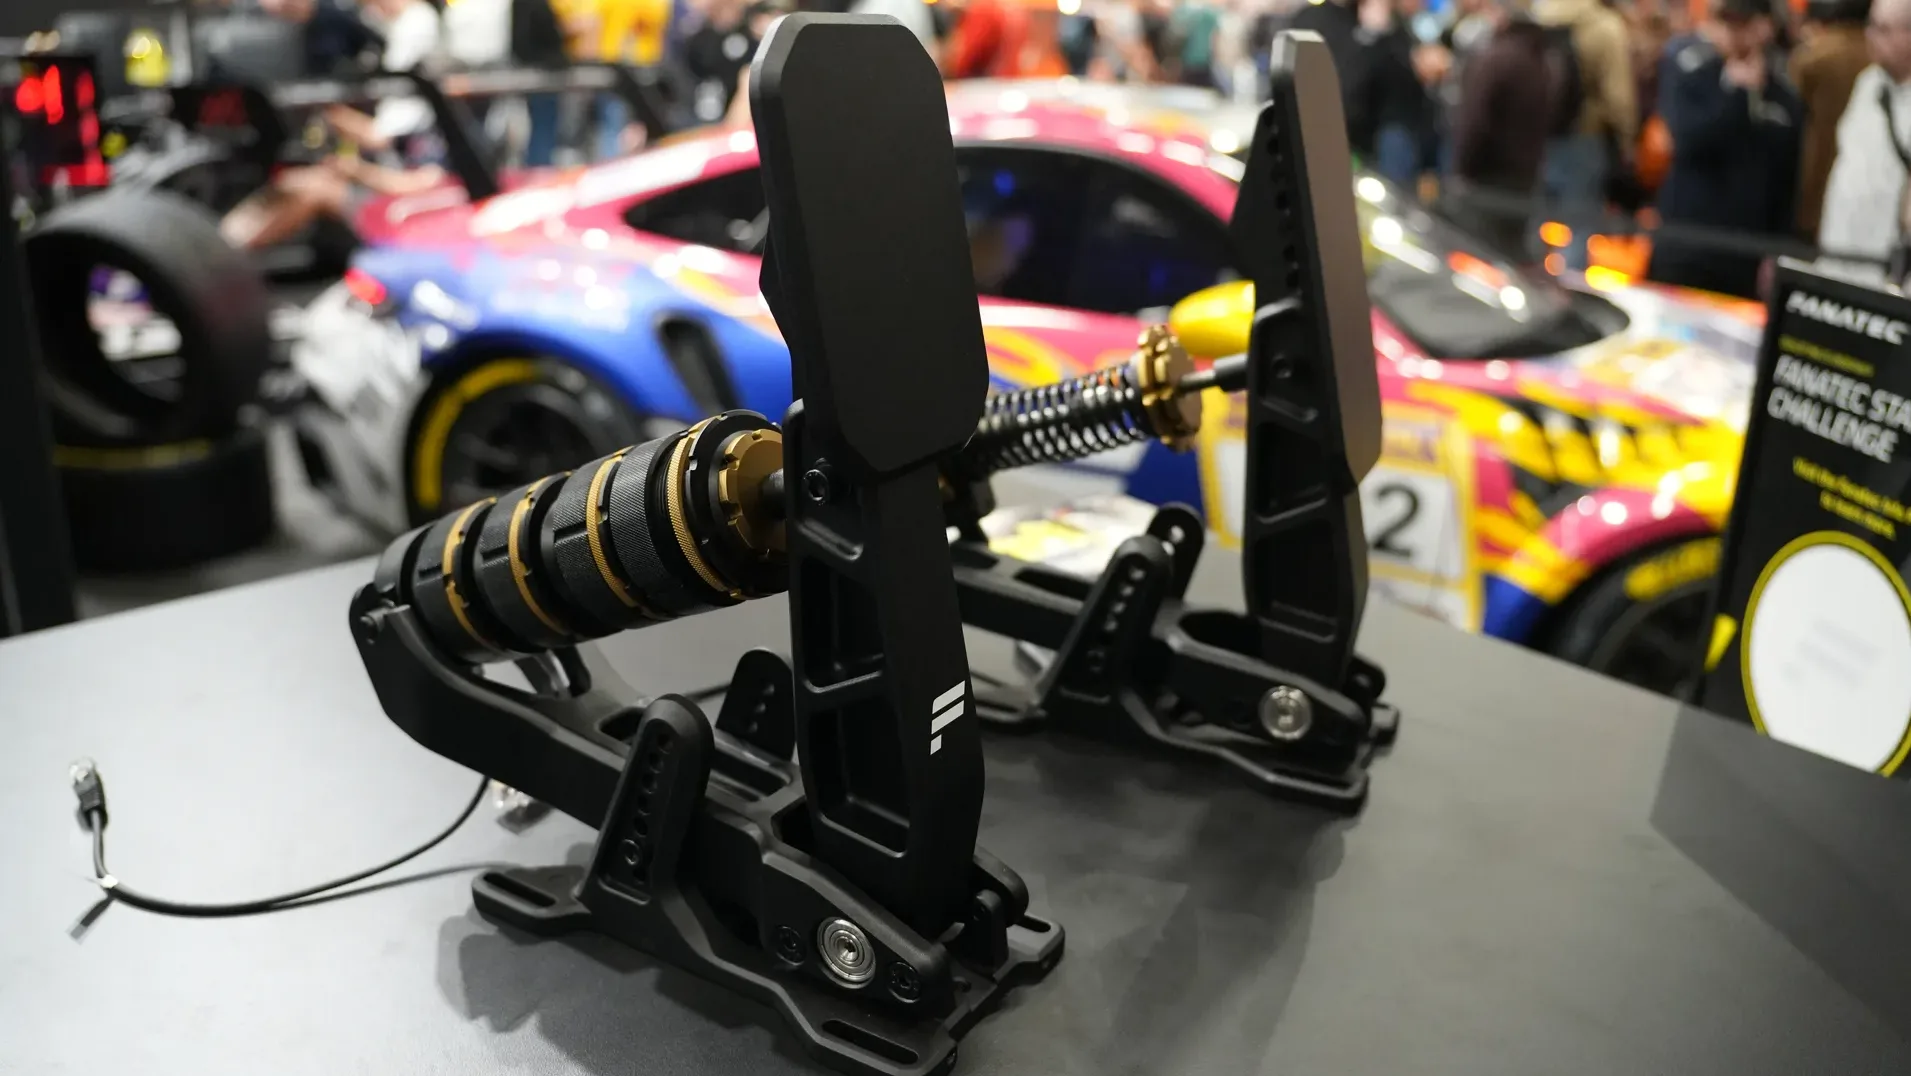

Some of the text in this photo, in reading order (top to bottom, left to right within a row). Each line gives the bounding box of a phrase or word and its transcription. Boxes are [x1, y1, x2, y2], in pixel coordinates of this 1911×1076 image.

[1786, 290, 1910, 345] FANATEC
[1773, 354, 1871, 416] FANATEC
[1767, 386, 1899, 464] CHALLENGE
[1373, 483, 1420, 559] 2
